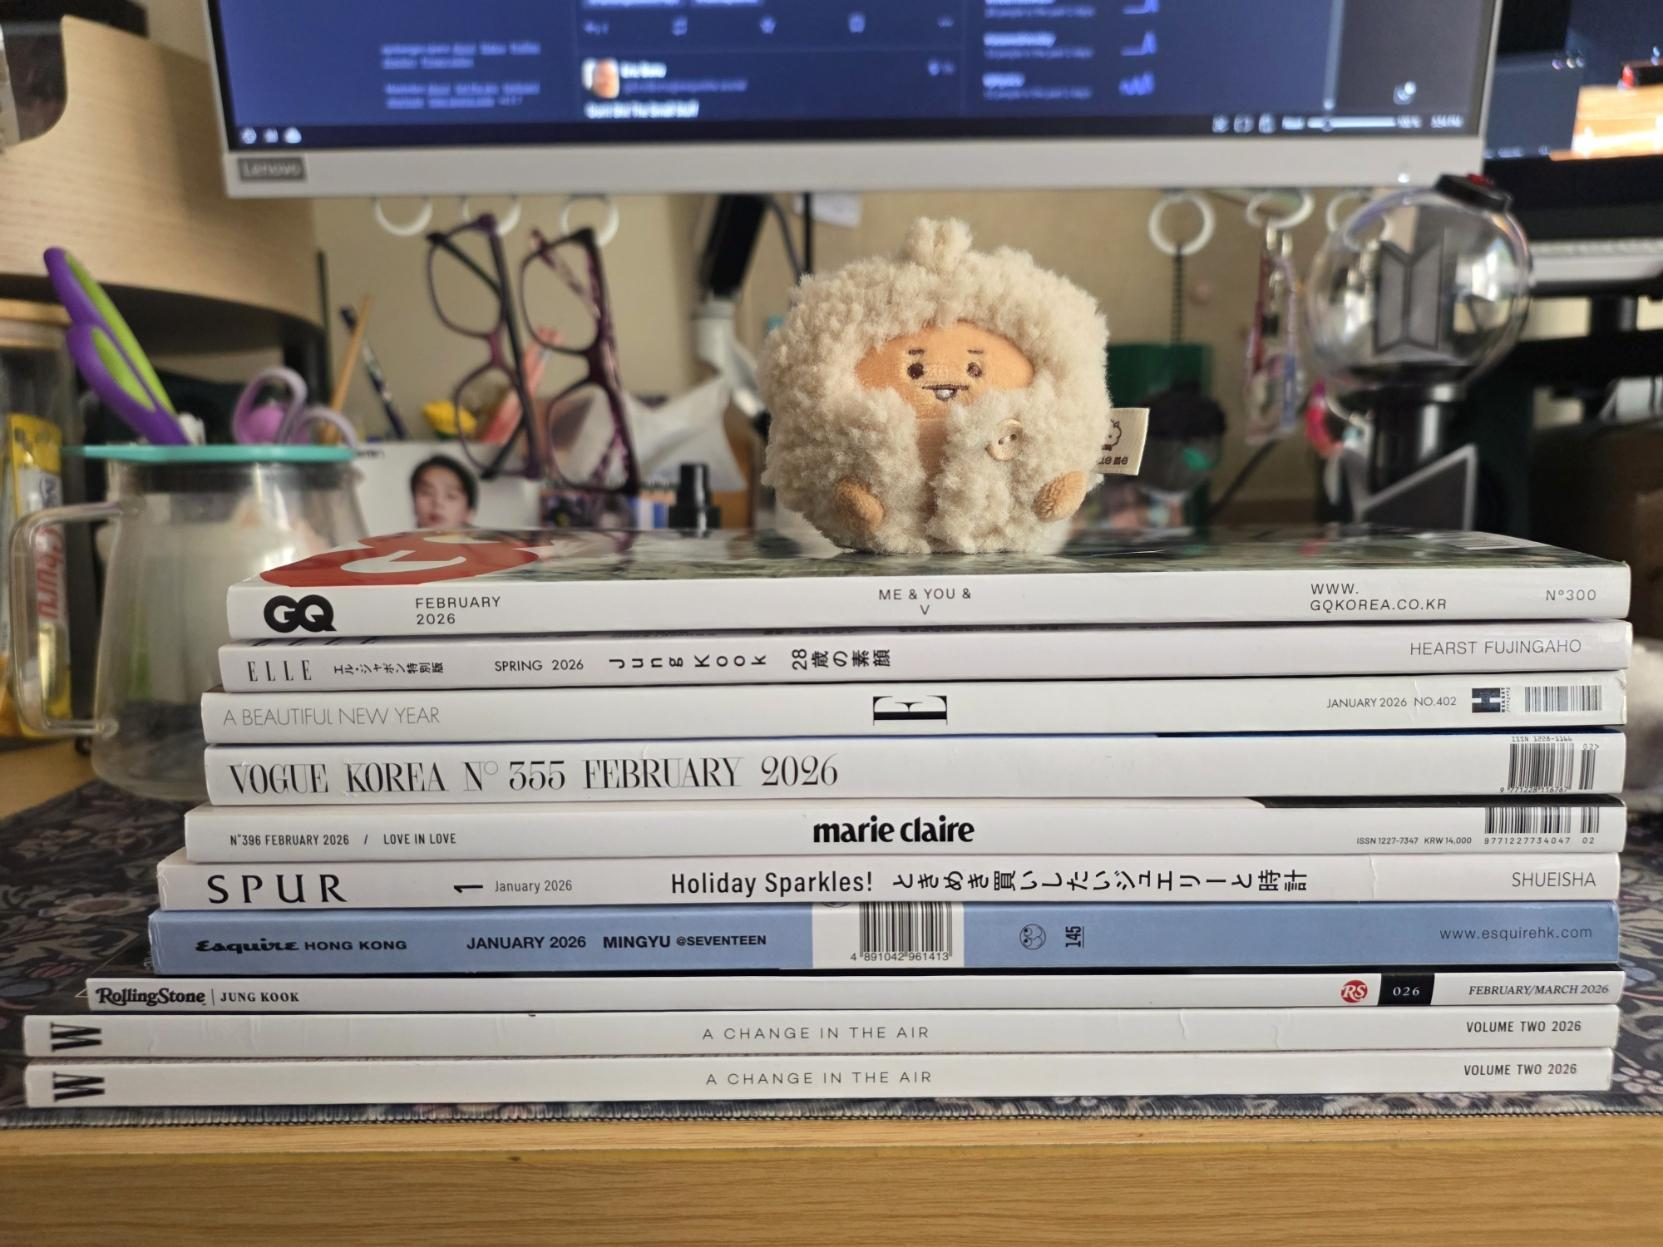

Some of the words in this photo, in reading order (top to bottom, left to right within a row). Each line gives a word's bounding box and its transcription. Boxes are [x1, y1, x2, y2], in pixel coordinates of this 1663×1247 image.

[879, 589, 901, 600] ME
[909, 589, 917, 600] &
[924, 588, 955, 599] YOU
[962, 588, 970, 599] &
[1311, 584, 1358, 594] WWW.
[416, 596, 500, 609] FEBRUARY
[1310, 599, 1446, 613] GQKOREA.CO.KR
[264, 595, 336, 633] GQ
[920, 605, 930, 615] V
[417, 613, 455, 625] 2026
[1411, 641, 1477, 655] HEARST
[1485, 639, 1581, 654] FUJINGAHO
[495, 660, 542, 671] SPRING
[552, 659, 583, 670] 2026
[609, 657, 683, 669] Jung
[694, 655, 766, 667] Kook
[792, 649, 890, 670] 28歳の素顔
[248, 660, 311, 681] ELLE
[1327, 698, 1376, 708] JANUARY
[1380, 697, 1407, 707] 2026
[1414, 697, 1456, 706] NO.402
[223, 710, 237, 726] A
[242, 708, 332, 725] BEAUTIFUL
[339, 708, 388, 725] NEW
[395, 707, 440, 724] YEAR
[227, 762, 329, 795] VOGUE
[345, 761, 448, 794] KOREA
[507, 758, 563, 793] 355
[581, 755, 745, 790] FEBRUARY
[760, 752, 839, 788] 2026
[814, 815, 894, 842] marie
[900, 815, 974, 842] claire
[265, 835, 318, 845] FEBRUARY
[323, 834, 349, 845] 2026
[384, 834, 410, 844] LOVE
[415, 834, 425, 844] IN
[430, 833, 456, 844] LOVE
[1375, 837, 1418, 845] 1227-7347
[1582, 836, 1595, 845] 02
[672, 872, 756, 897] Holiday
[765, 871, 871, 897] Sparkles!
[1512, 872, 1596, 887] SHUEISHA
[208, 875, 347, 904] SPUR
[495, 881, 540, 894] January
[544, 880, 572, 891] 2026
[1065, 925, 1082, 948] 145
[1440, 927, 1592, 941] www.esquirehk.com
[195, 938, 299, 954] Esquire
[305, 941, 353, 951] HONG
[359, 941, 407, 950] KONG
[467, 937, 544, 949] JANUARY
[550, 936, 586, 948] 2026
[603, 936, 670, 948] MINGYU
[677, 936, 766, 946] @SEVENTEEN
[863, 952, 904, 961] 891042
[908, 952, 949, 961] 961413
[1341, 984, 1368, 1002] RS
[1392, 986, 1421, 997] 026
[1469, 985, 1578, 995] FEBRUARY/MARCH
[1580, 985, 1609, 994] 2026
[220, 993, 255, 1002] JUNG
[261, 992, 299, 1002] KOOK
[1467, 1022, 1513, 1032] VOLUME
[1521, 1021, 1545, 1032] TWO
[1552, 1021, 1581, 1031] 2026
[50, 1023, 102, 1052] W
[703, 1029, 713, 1040] A
[724, 1027, 809, 1040] CHANGE
[821, 1028, 838, 1039] IN
[849, 1027, 885, 1038] THE
[897, 1027, 928, 1038] AIR
[1464, 1065, 1510, 1075] VOLUME
[1517, 1064, 1542, 1075] TWO
[1548, 1064, 1576, 1074] 2026
[706, 1074, 717, 1085] A
[728, 1073, 812, 1085] CHANGE
[824, 1072, 841, 1083] IN
[852, 1072, 888, 1083] THE
[900, 1072, 931, 1082] AIR
[53, 1073, 105, 1102] W
